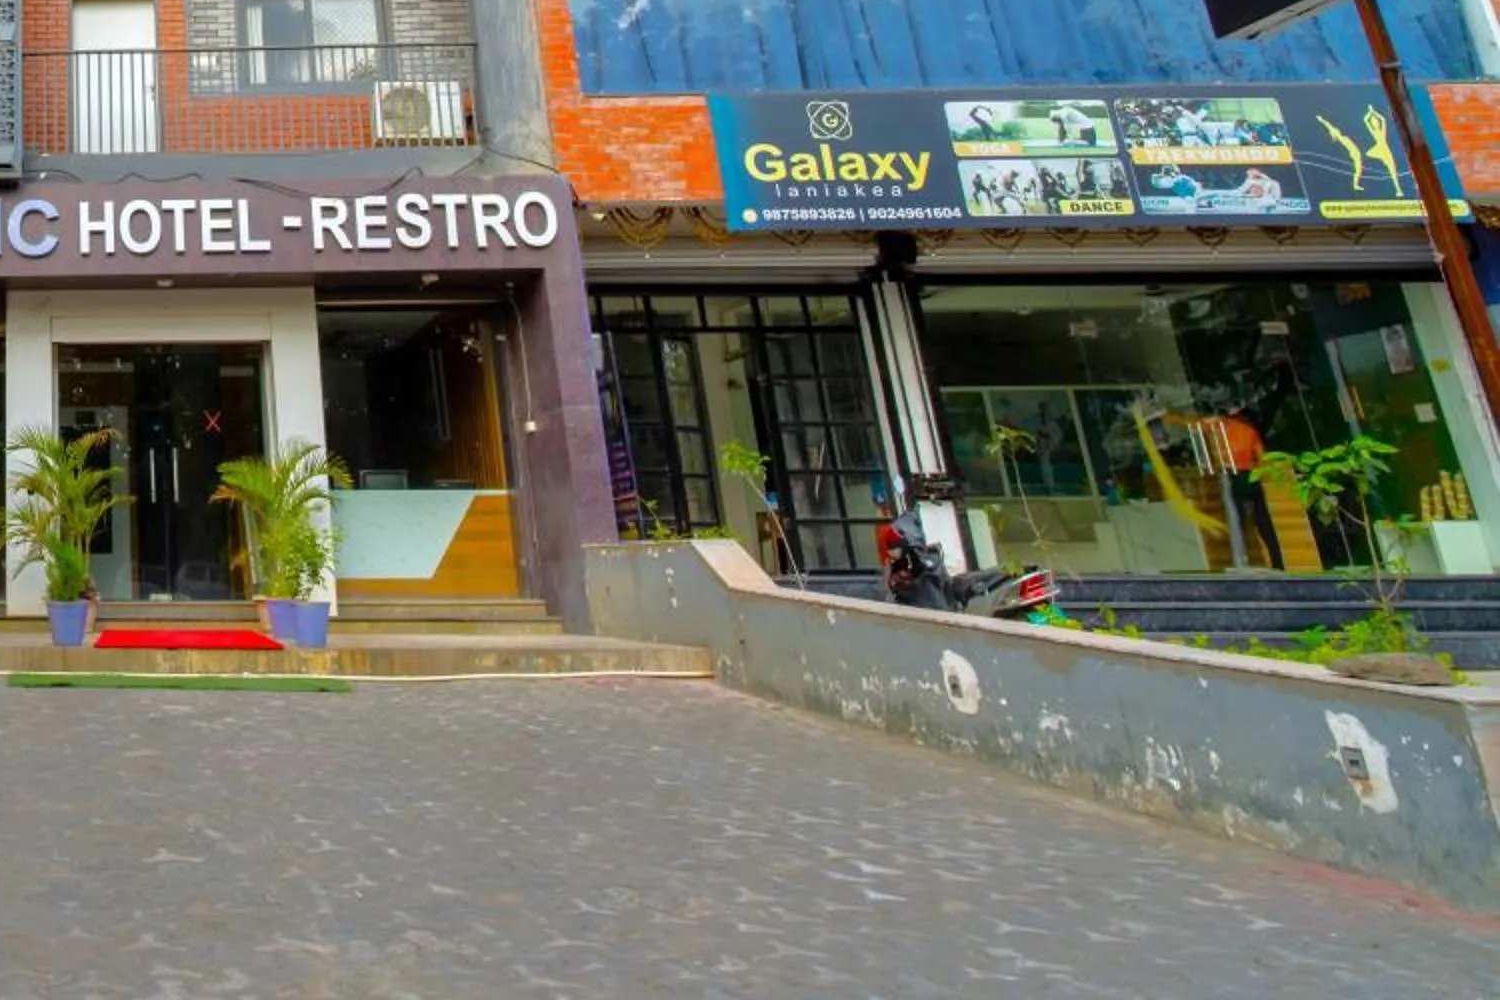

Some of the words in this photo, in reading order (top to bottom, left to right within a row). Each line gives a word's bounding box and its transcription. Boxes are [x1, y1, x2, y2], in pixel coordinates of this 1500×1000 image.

[1144, 148, 1280, 161] TAEKWONDO
[744, 143, 931, 191] Galaxy
[775, 183, 903, 197] laniakea
[1070, 201, 1124, 213] DANCE
[79, 199, 271, 255] HOTEL
